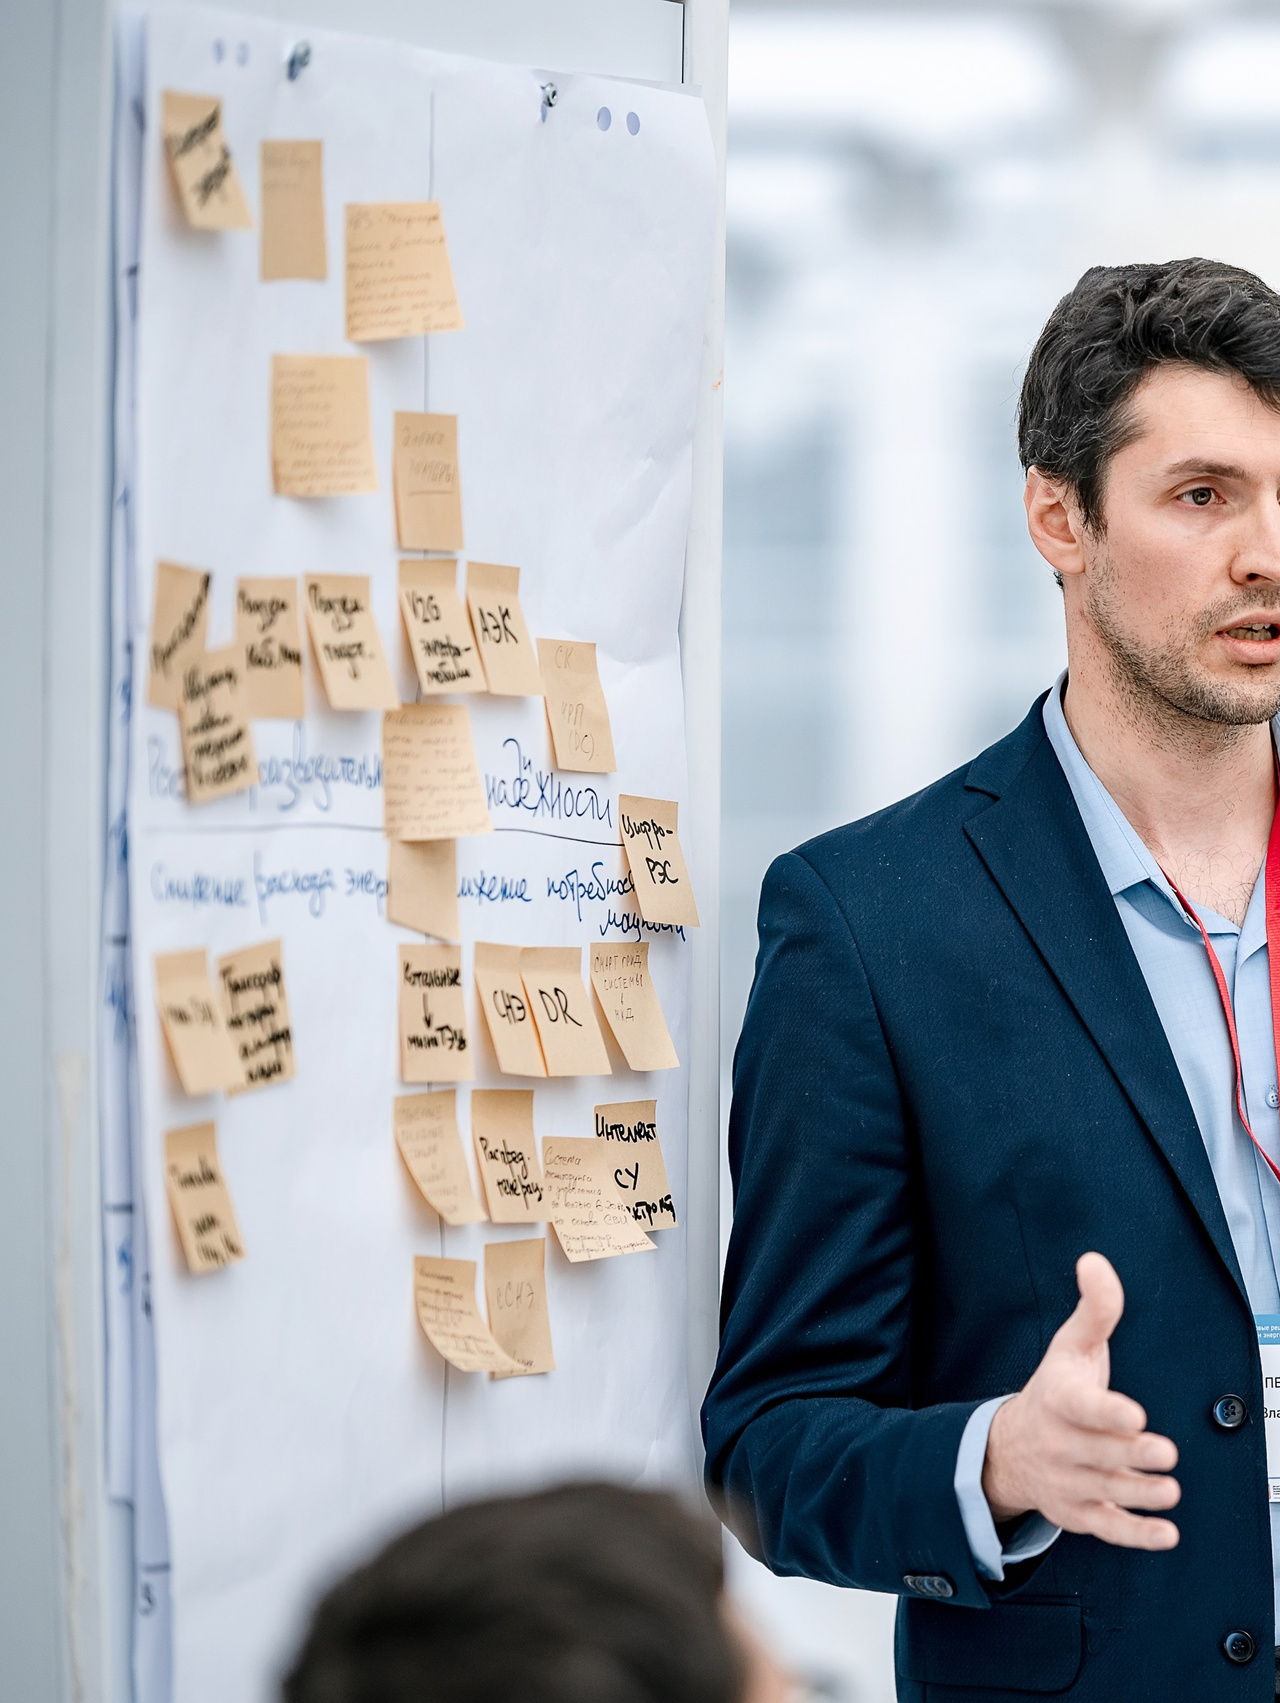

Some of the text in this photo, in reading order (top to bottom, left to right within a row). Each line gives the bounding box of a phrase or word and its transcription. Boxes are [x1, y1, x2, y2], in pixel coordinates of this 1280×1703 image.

[405, 590, 440, 622] V2G
[478, 605, 519, 644] АЭК
[645, 856, 679, 885] РЭС
[344, 868, 389, 917] энер
[457, 869, 532, 902] ижение
[492, 989, 526, 1025] СНЭ
[538, 987, 583, 1027] DR
[614, 1162, 639, 1191] СУ
